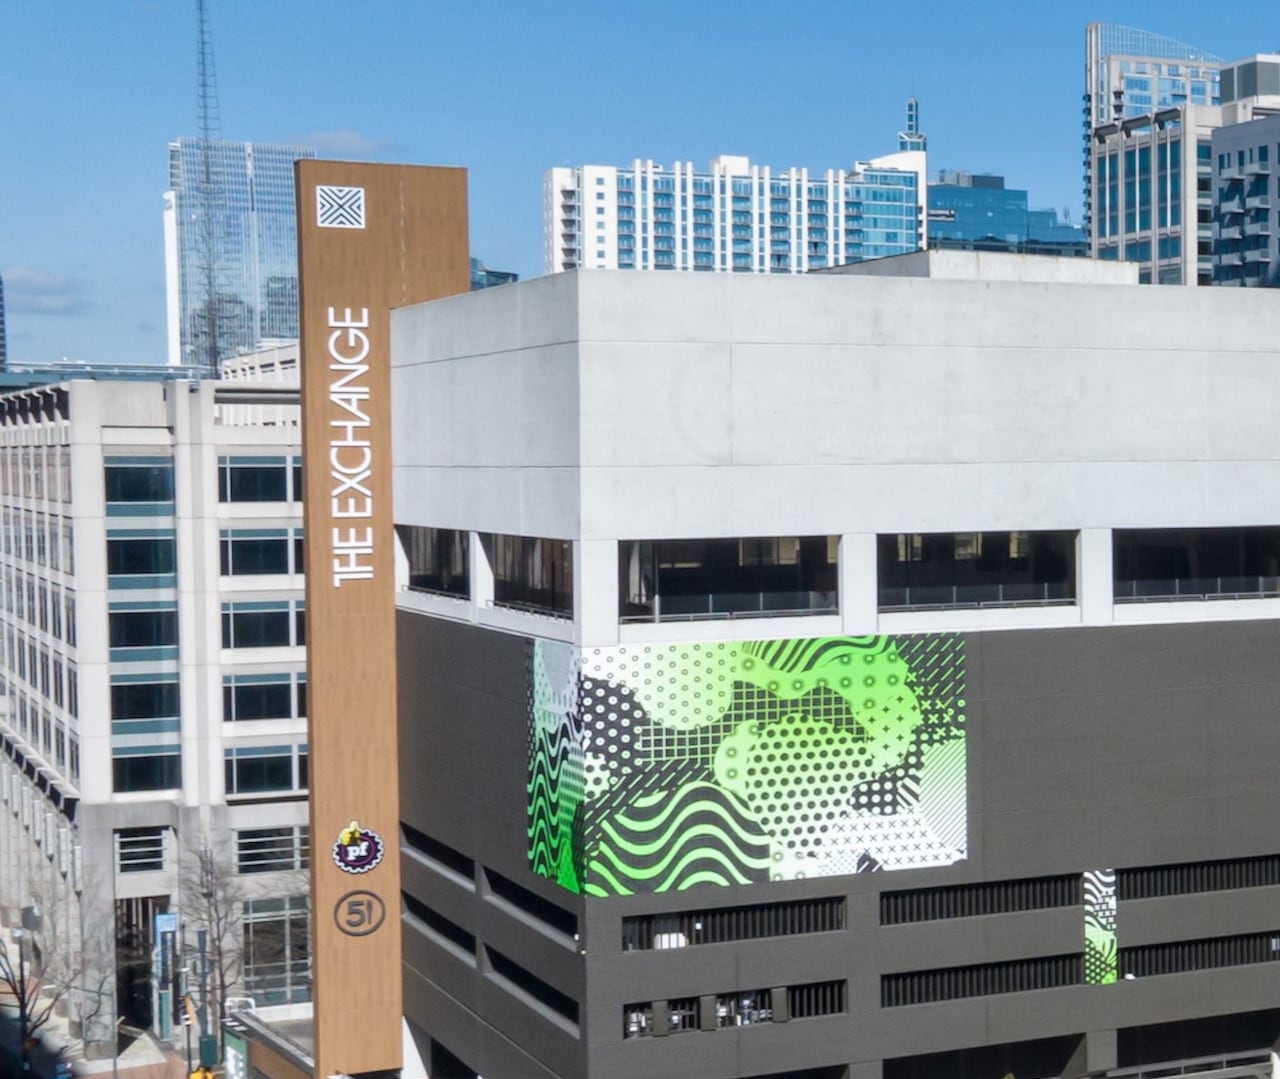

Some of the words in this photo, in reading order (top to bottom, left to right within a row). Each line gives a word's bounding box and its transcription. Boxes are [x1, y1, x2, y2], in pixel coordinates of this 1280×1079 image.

[328, 307, 373, 518] EXCHANGE
[332, 526, 374, 588] THE
[346, 841, 369, 860] pf
